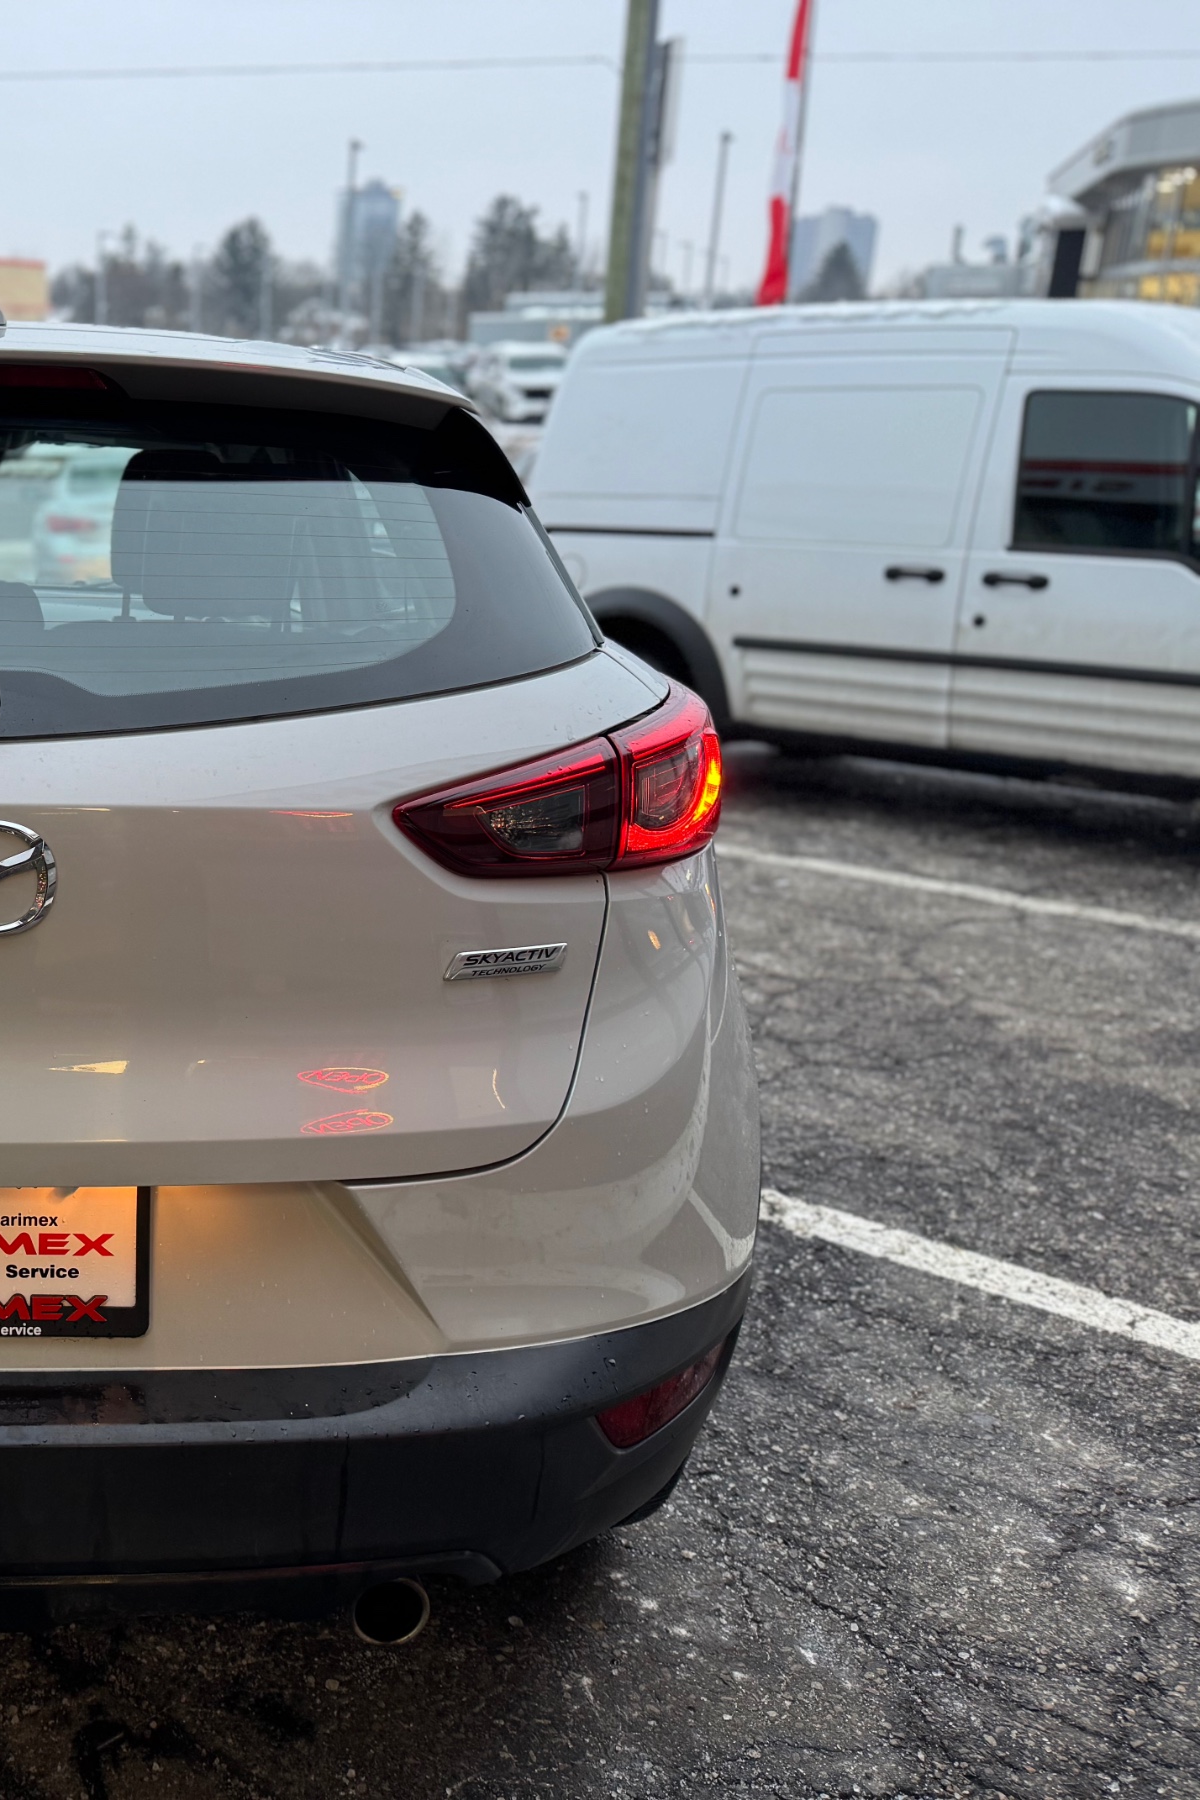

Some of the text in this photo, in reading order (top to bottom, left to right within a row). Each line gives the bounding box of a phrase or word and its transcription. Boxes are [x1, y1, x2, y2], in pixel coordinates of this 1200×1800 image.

[463, 947, 558, 966] SKYACTIV
[472, 963, 547, 977] TECHNOLOGY
[5, 1264, 80, 1279] Service
